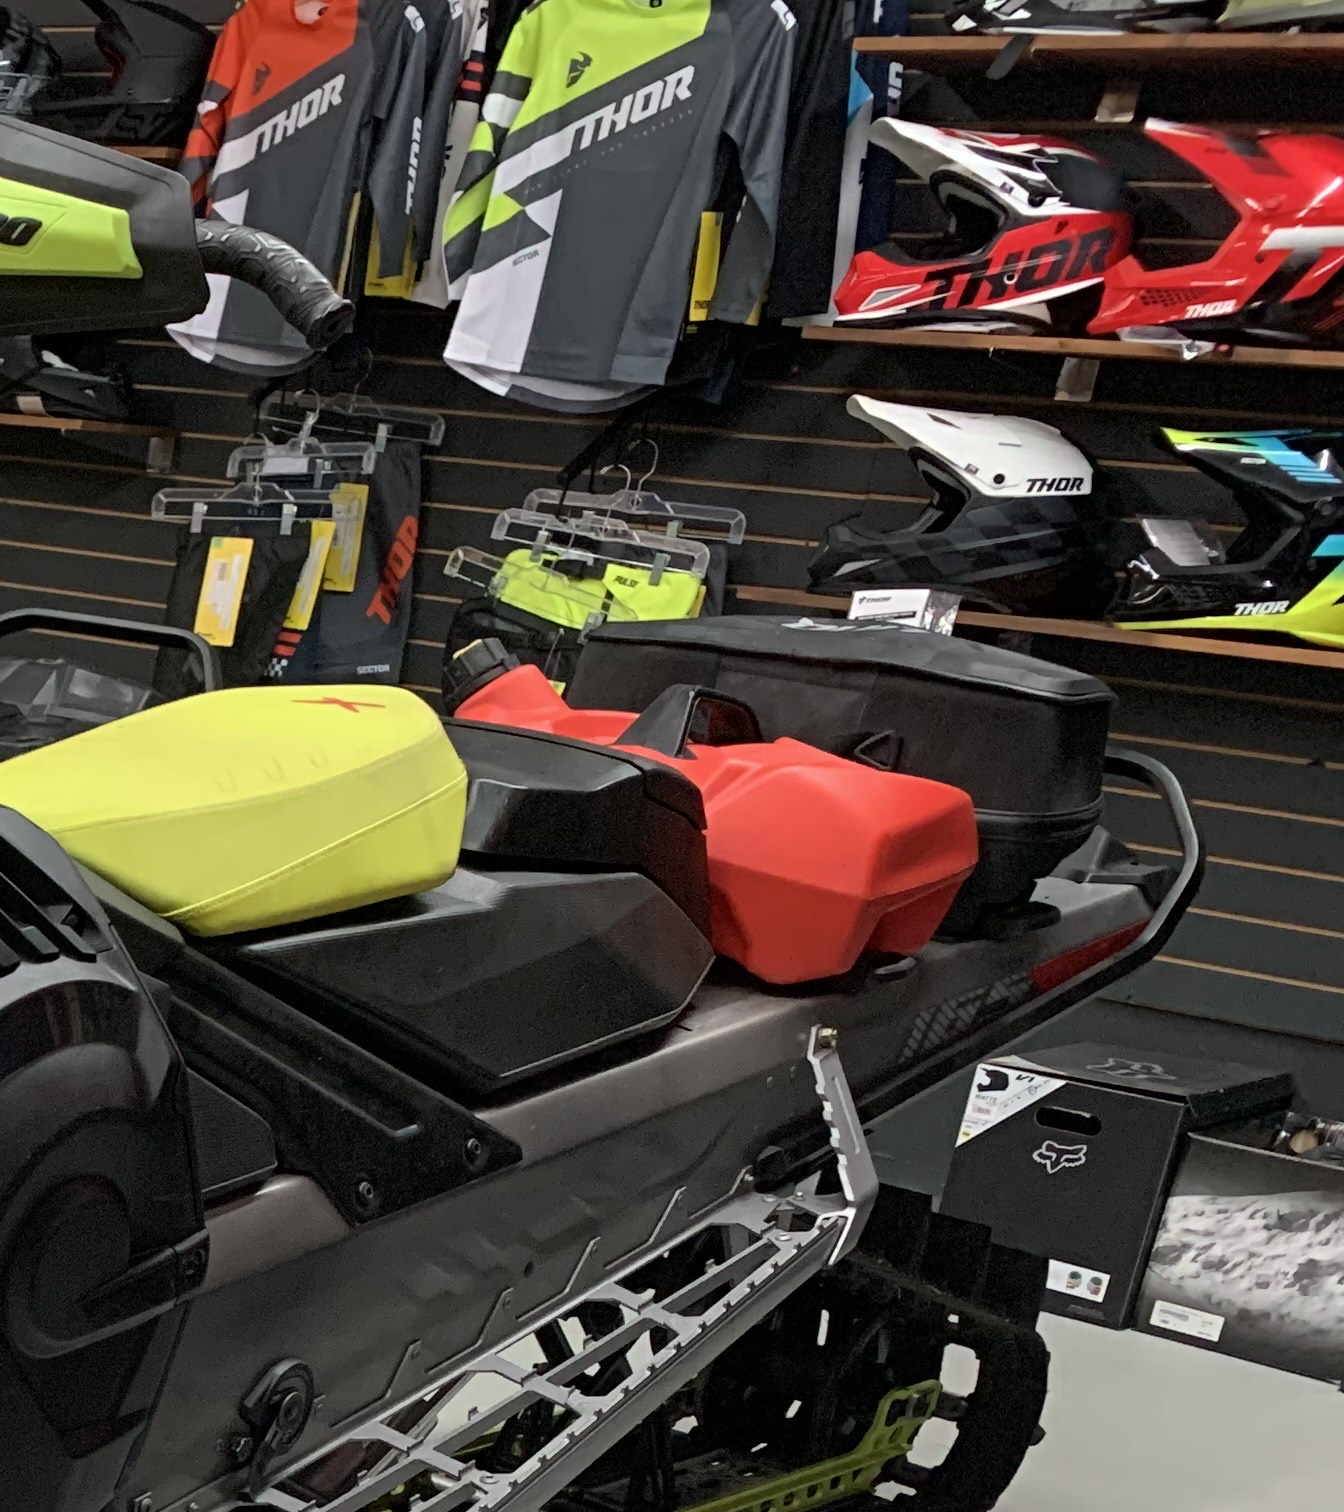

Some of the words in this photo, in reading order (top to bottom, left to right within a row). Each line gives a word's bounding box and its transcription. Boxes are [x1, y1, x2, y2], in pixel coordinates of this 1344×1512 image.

[258, 73, 346, 153] THOR
[570, 65, 695, 150] THOR
[922, 226, 1113, 311] THOR
[1184, 299, 1237, 319] THOR
[1026, 477, 1084, 493] THOR
[366, 515, 419, 625] THOR
[1233, 600, 1290, 616] THOR
